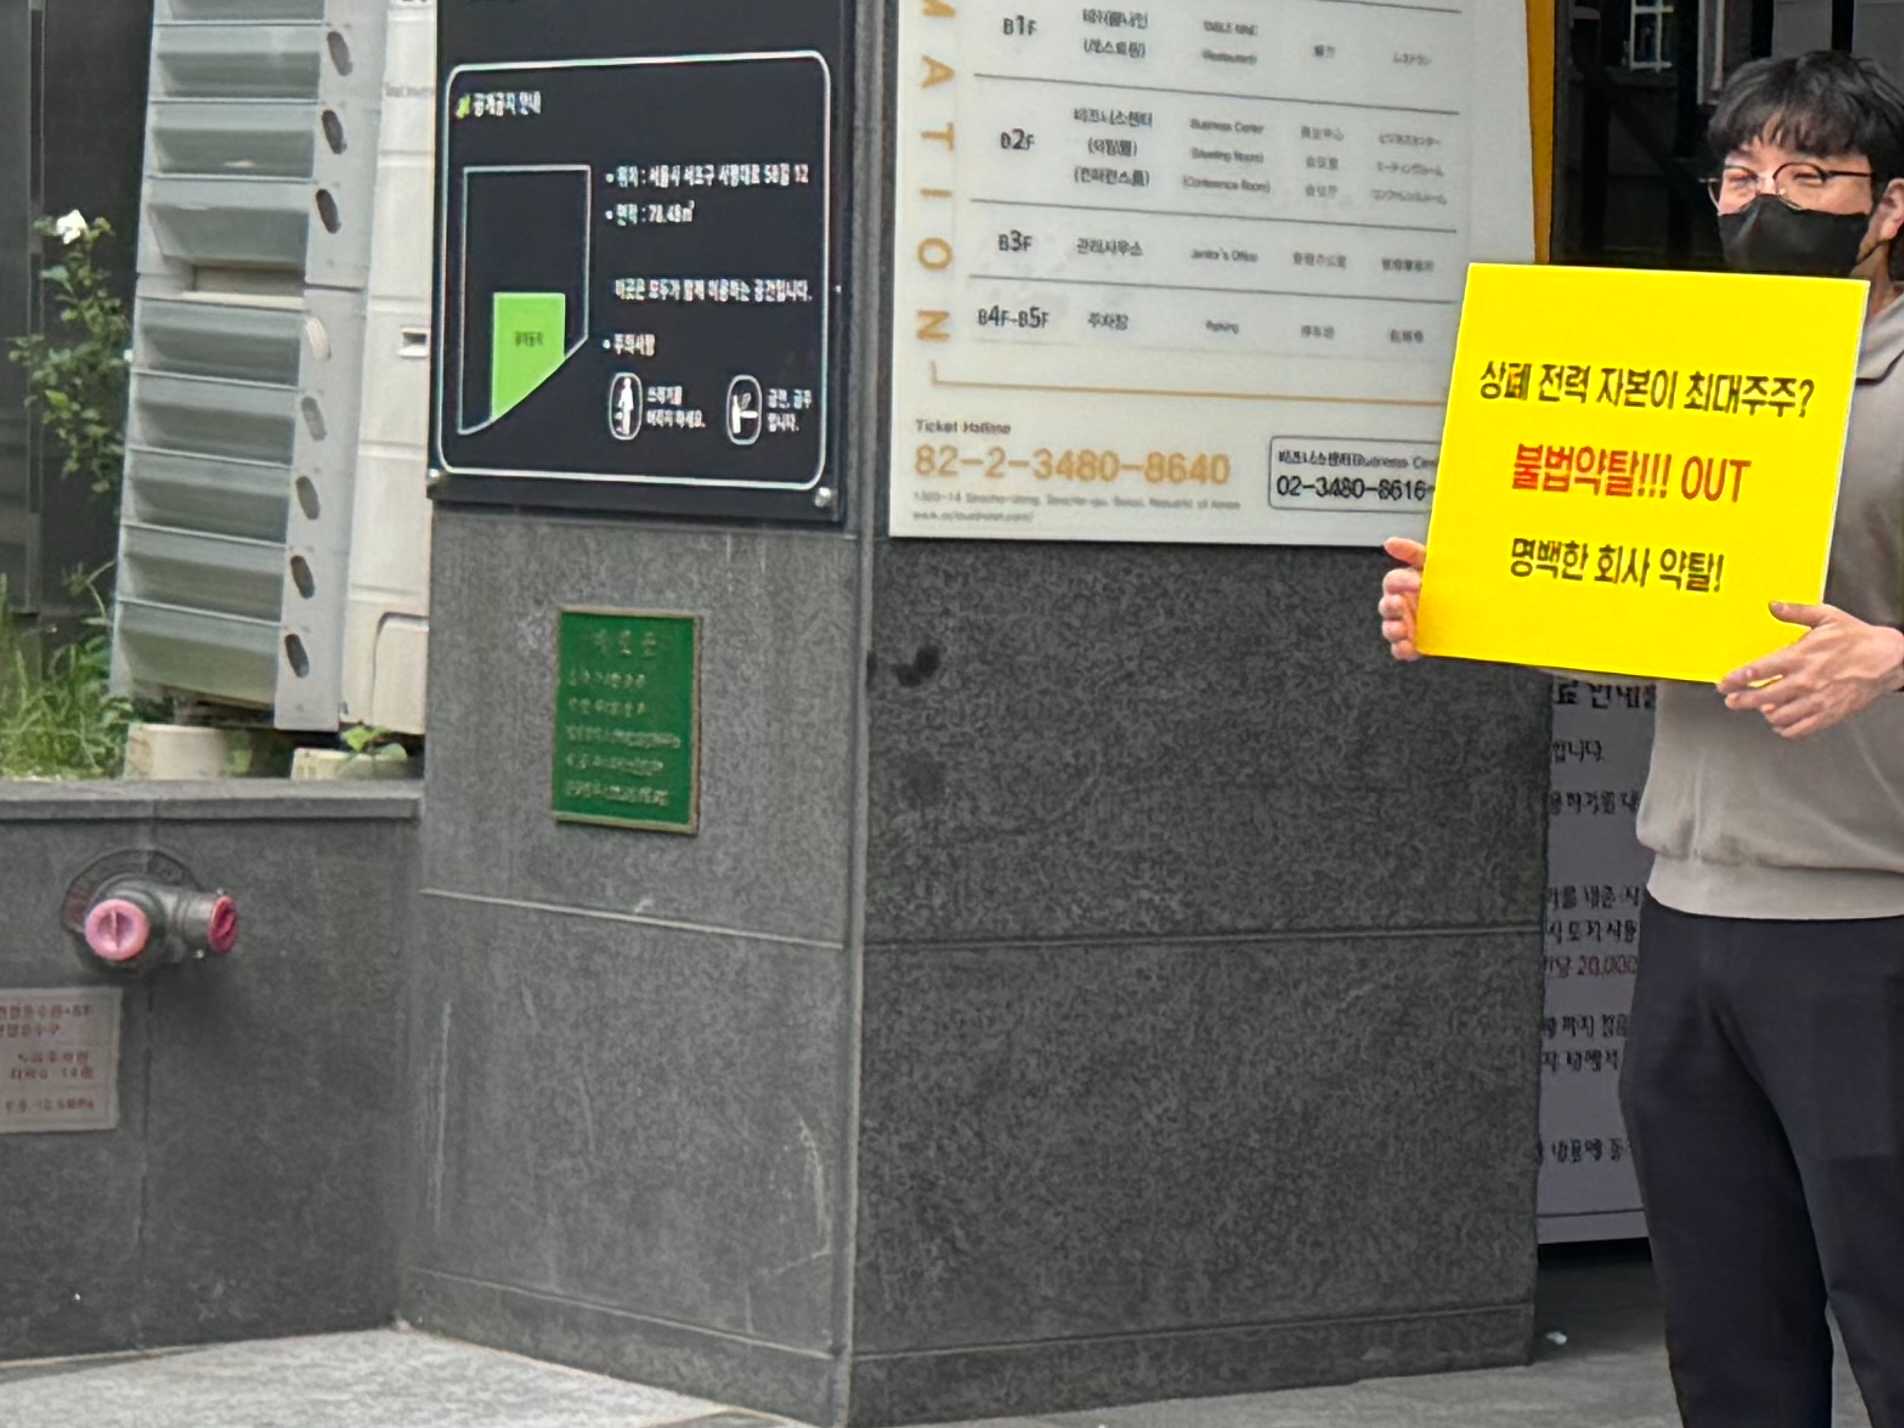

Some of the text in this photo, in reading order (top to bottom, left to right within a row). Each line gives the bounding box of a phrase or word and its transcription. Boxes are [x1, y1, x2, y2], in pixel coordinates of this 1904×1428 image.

[1537, 363, 1591, 404] 전력
[1596, 368, 1679, 410] 자본이
[1683, 370, 1815, 419] 최대주주?
[914, 444, 1231, 486] 82-2-3480-8640
[1511, 442, 1752, 503] 불법약탈!!! OUT
[1510, 537, 1725, 593] 명백한 회사 약탈!
